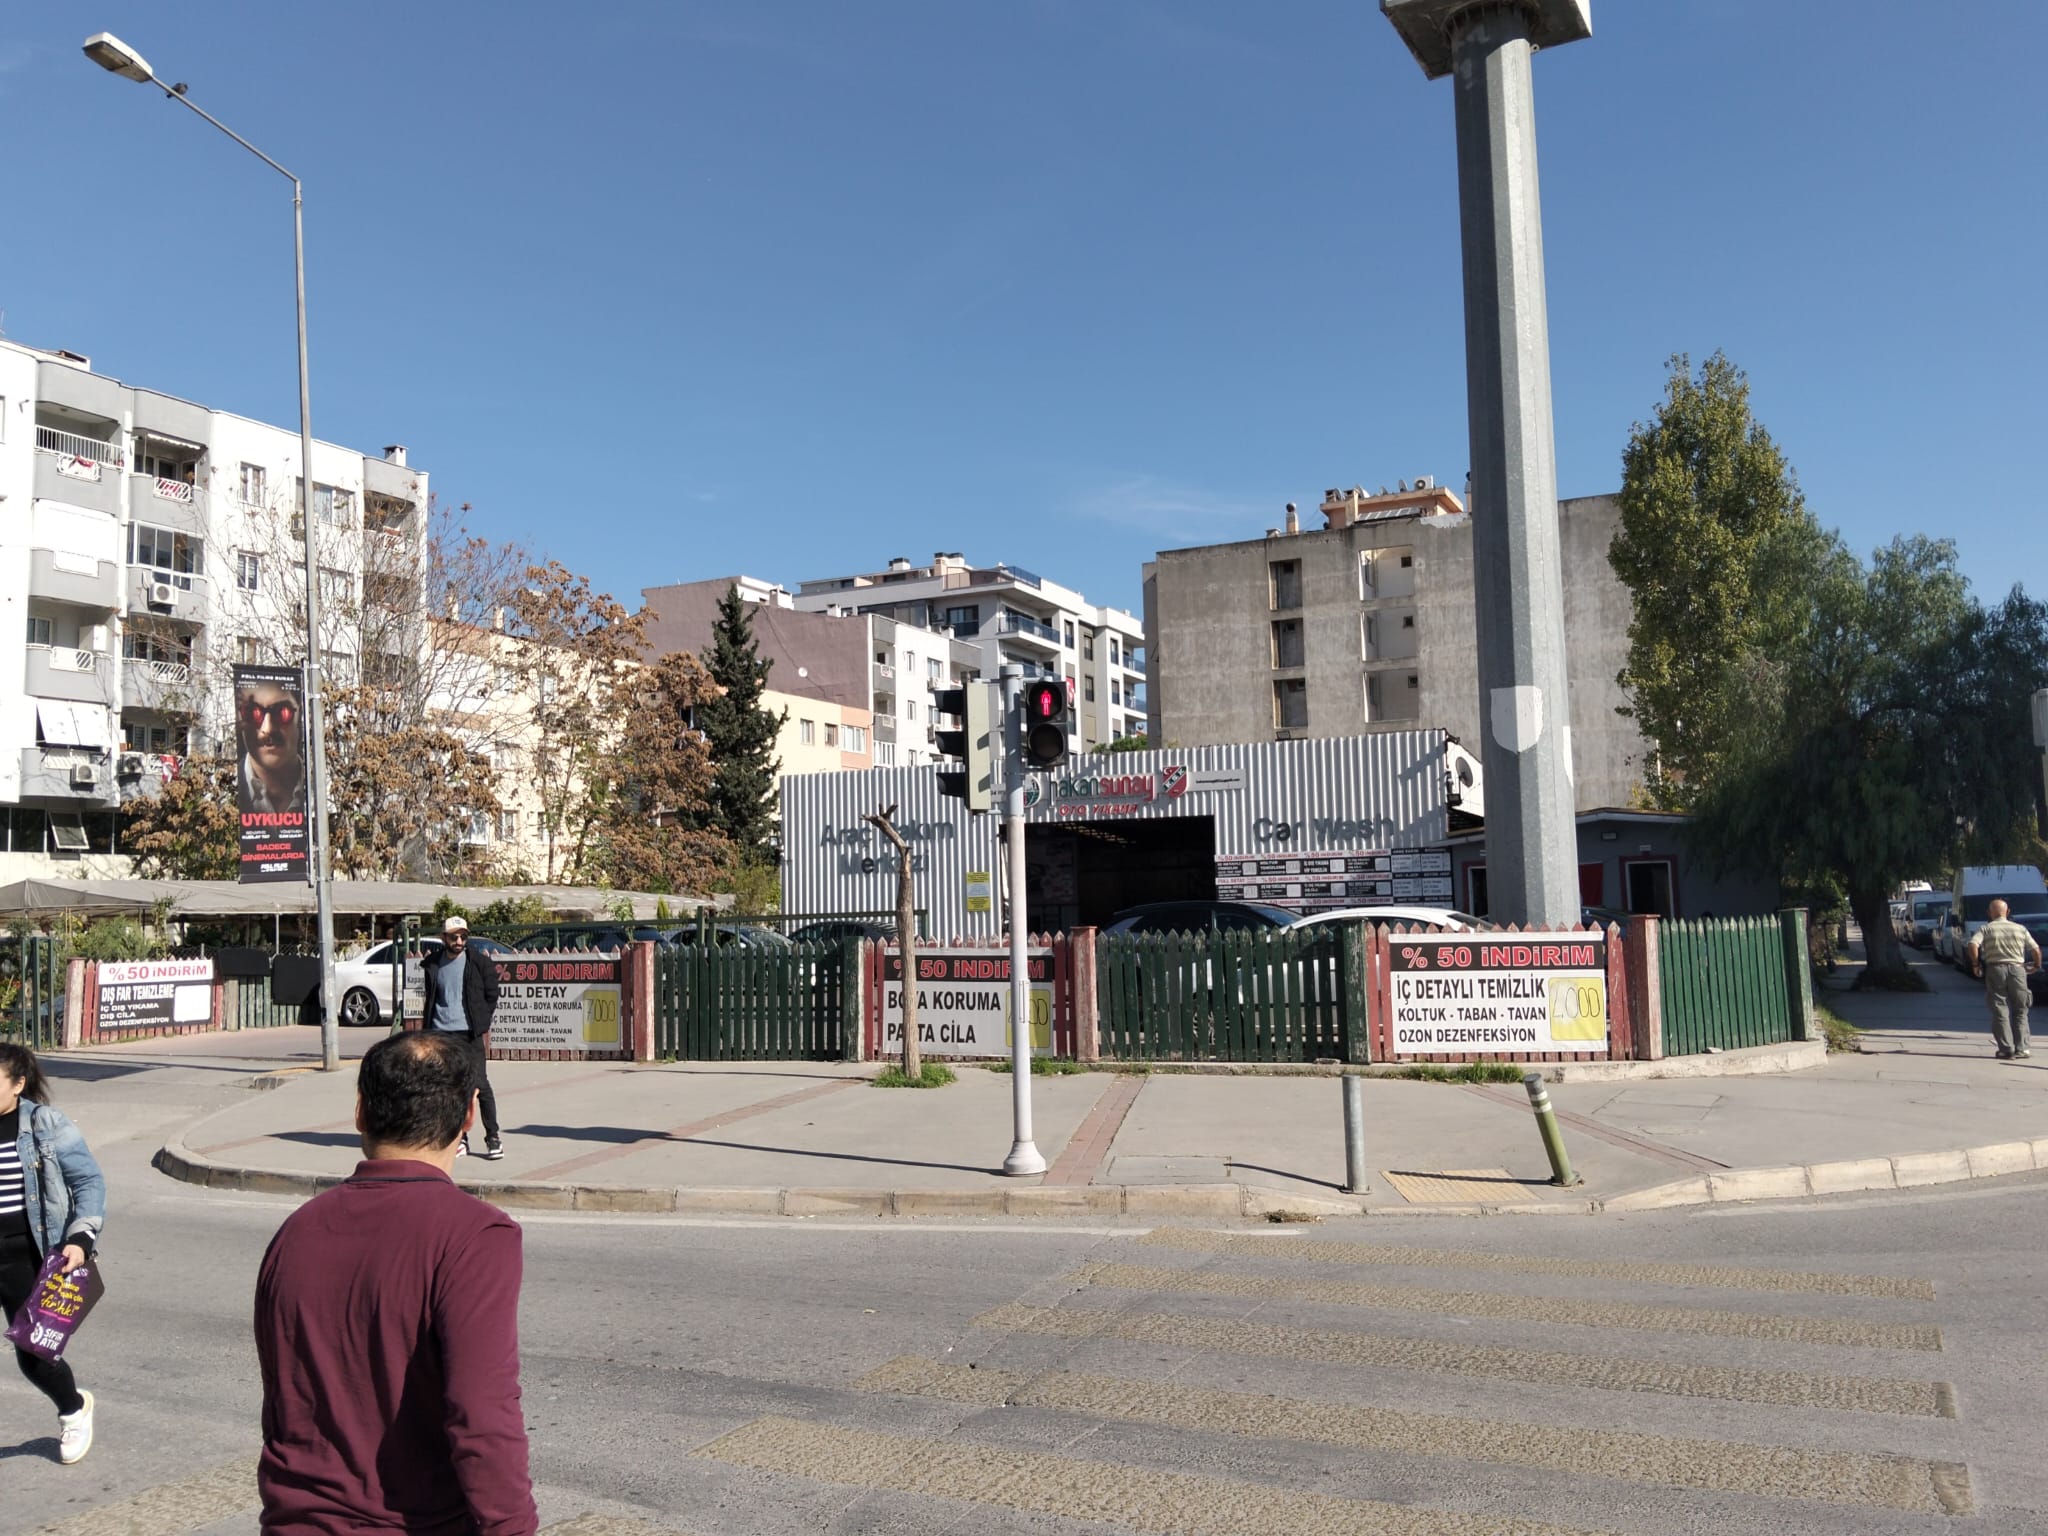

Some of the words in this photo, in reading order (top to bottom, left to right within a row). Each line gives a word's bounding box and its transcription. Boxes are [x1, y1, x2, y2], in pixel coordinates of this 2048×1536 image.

[242, 812, 302, 827] UYKUCU
[1253, 816, 1303, 842] Car
[1314, 813, 1394, 842] Wash
[820, 825, 872, 848] Araç
[839, 849, 930, 874] Merkzi
[1402, 947, 1428, 968] %
[1437, 947, 1472, 968] 50
[109, 967, 124, 981] %
[128, 966, 149, 980] 50
[495, 964, 511, 981] %
[516, 964, 538, 980] 50
[920, 960, 947, 977] 50
[101, 986, 116, 1005] DIŞ
[116, 986, 132, 1000] FAR
[498, 986, 522, 998] ULL
[526, 986, 567, 998] DETAY
[1397, 974, 1411, 1004] İÇ
[1416, 978, 1473, 999] DETAYLI
[1478, 973, 1545, 998] TEMİZLİK
[496, 1002, 511, 1010] ASTA
[513, 1000, 528, 1010] CİLA
[534, 1002, 550, 1010] BOYA
[553, 1002, 582, 1010] KORUMA
[933, 991, 1001, 1010] KORUMA
[500, 1015, 526, 1024] DETAYLI
[528, 1014, 559, 1024] TEMİZLİK
[1398, 1008, 1446, 1021] KOLTUK
[1457, 1008, 1497, 1020] TABAN
[1507, 1007, 1546, 1020] TAVAN
[888, 1023, 935, 1042] PATA
[940, 1020, 976, 1043] CİLA
[1399, 1030, 1432, 1043] OZON
[1437, 1025, 1536, 1042] DEZENFEKSİYON
[39, 1338, 60, 1351] ATIK
